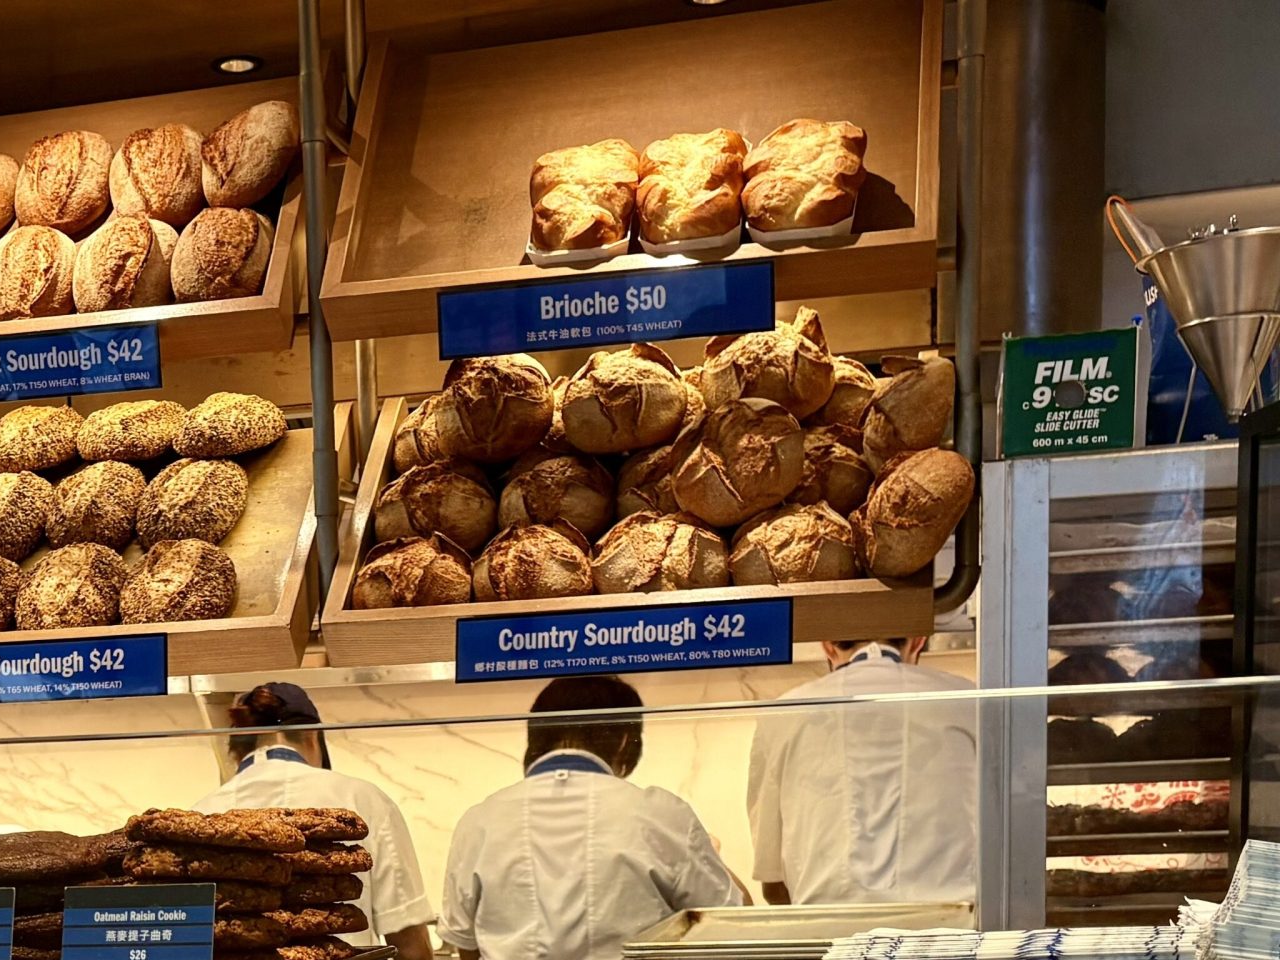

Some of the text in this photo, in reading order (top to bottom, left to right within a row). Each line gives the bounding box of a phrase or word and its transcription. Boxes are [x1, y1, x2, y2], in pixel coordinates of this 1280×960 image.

[540, 285, 666, 320] Brioche $50
[596, 320, 682, 337] (100% T45 WHEAT)
[6, 343, 101, 372] Sourdough
[108, 339, 143, 365] $42
[94, 373, 122, 384] WHEAT
[1046, 411, 1070, 421] EASY
[1035, 419, 1099, 432] SLIDE CUTTER
[1033, 438, 1051, 447] 600
[1054, 438, 1064, 446] m
[1076, 435, 1088, 444] 45
[1092, 435, 1107, 443] cm
[499, 614, 745, 652] Country Sourdough $42
[89, 648, 124, 673] $42
[628, 654, 649, 664] T150
[689, 650, 710, 661] 80%
[732, 646, 770, 658] WHEAT)
[90, 680, 122, 690] WHEAT)
[94, 910, 186, 922] Oatmeal Raisin Cookie
[130, 950, 146, 960] $26
